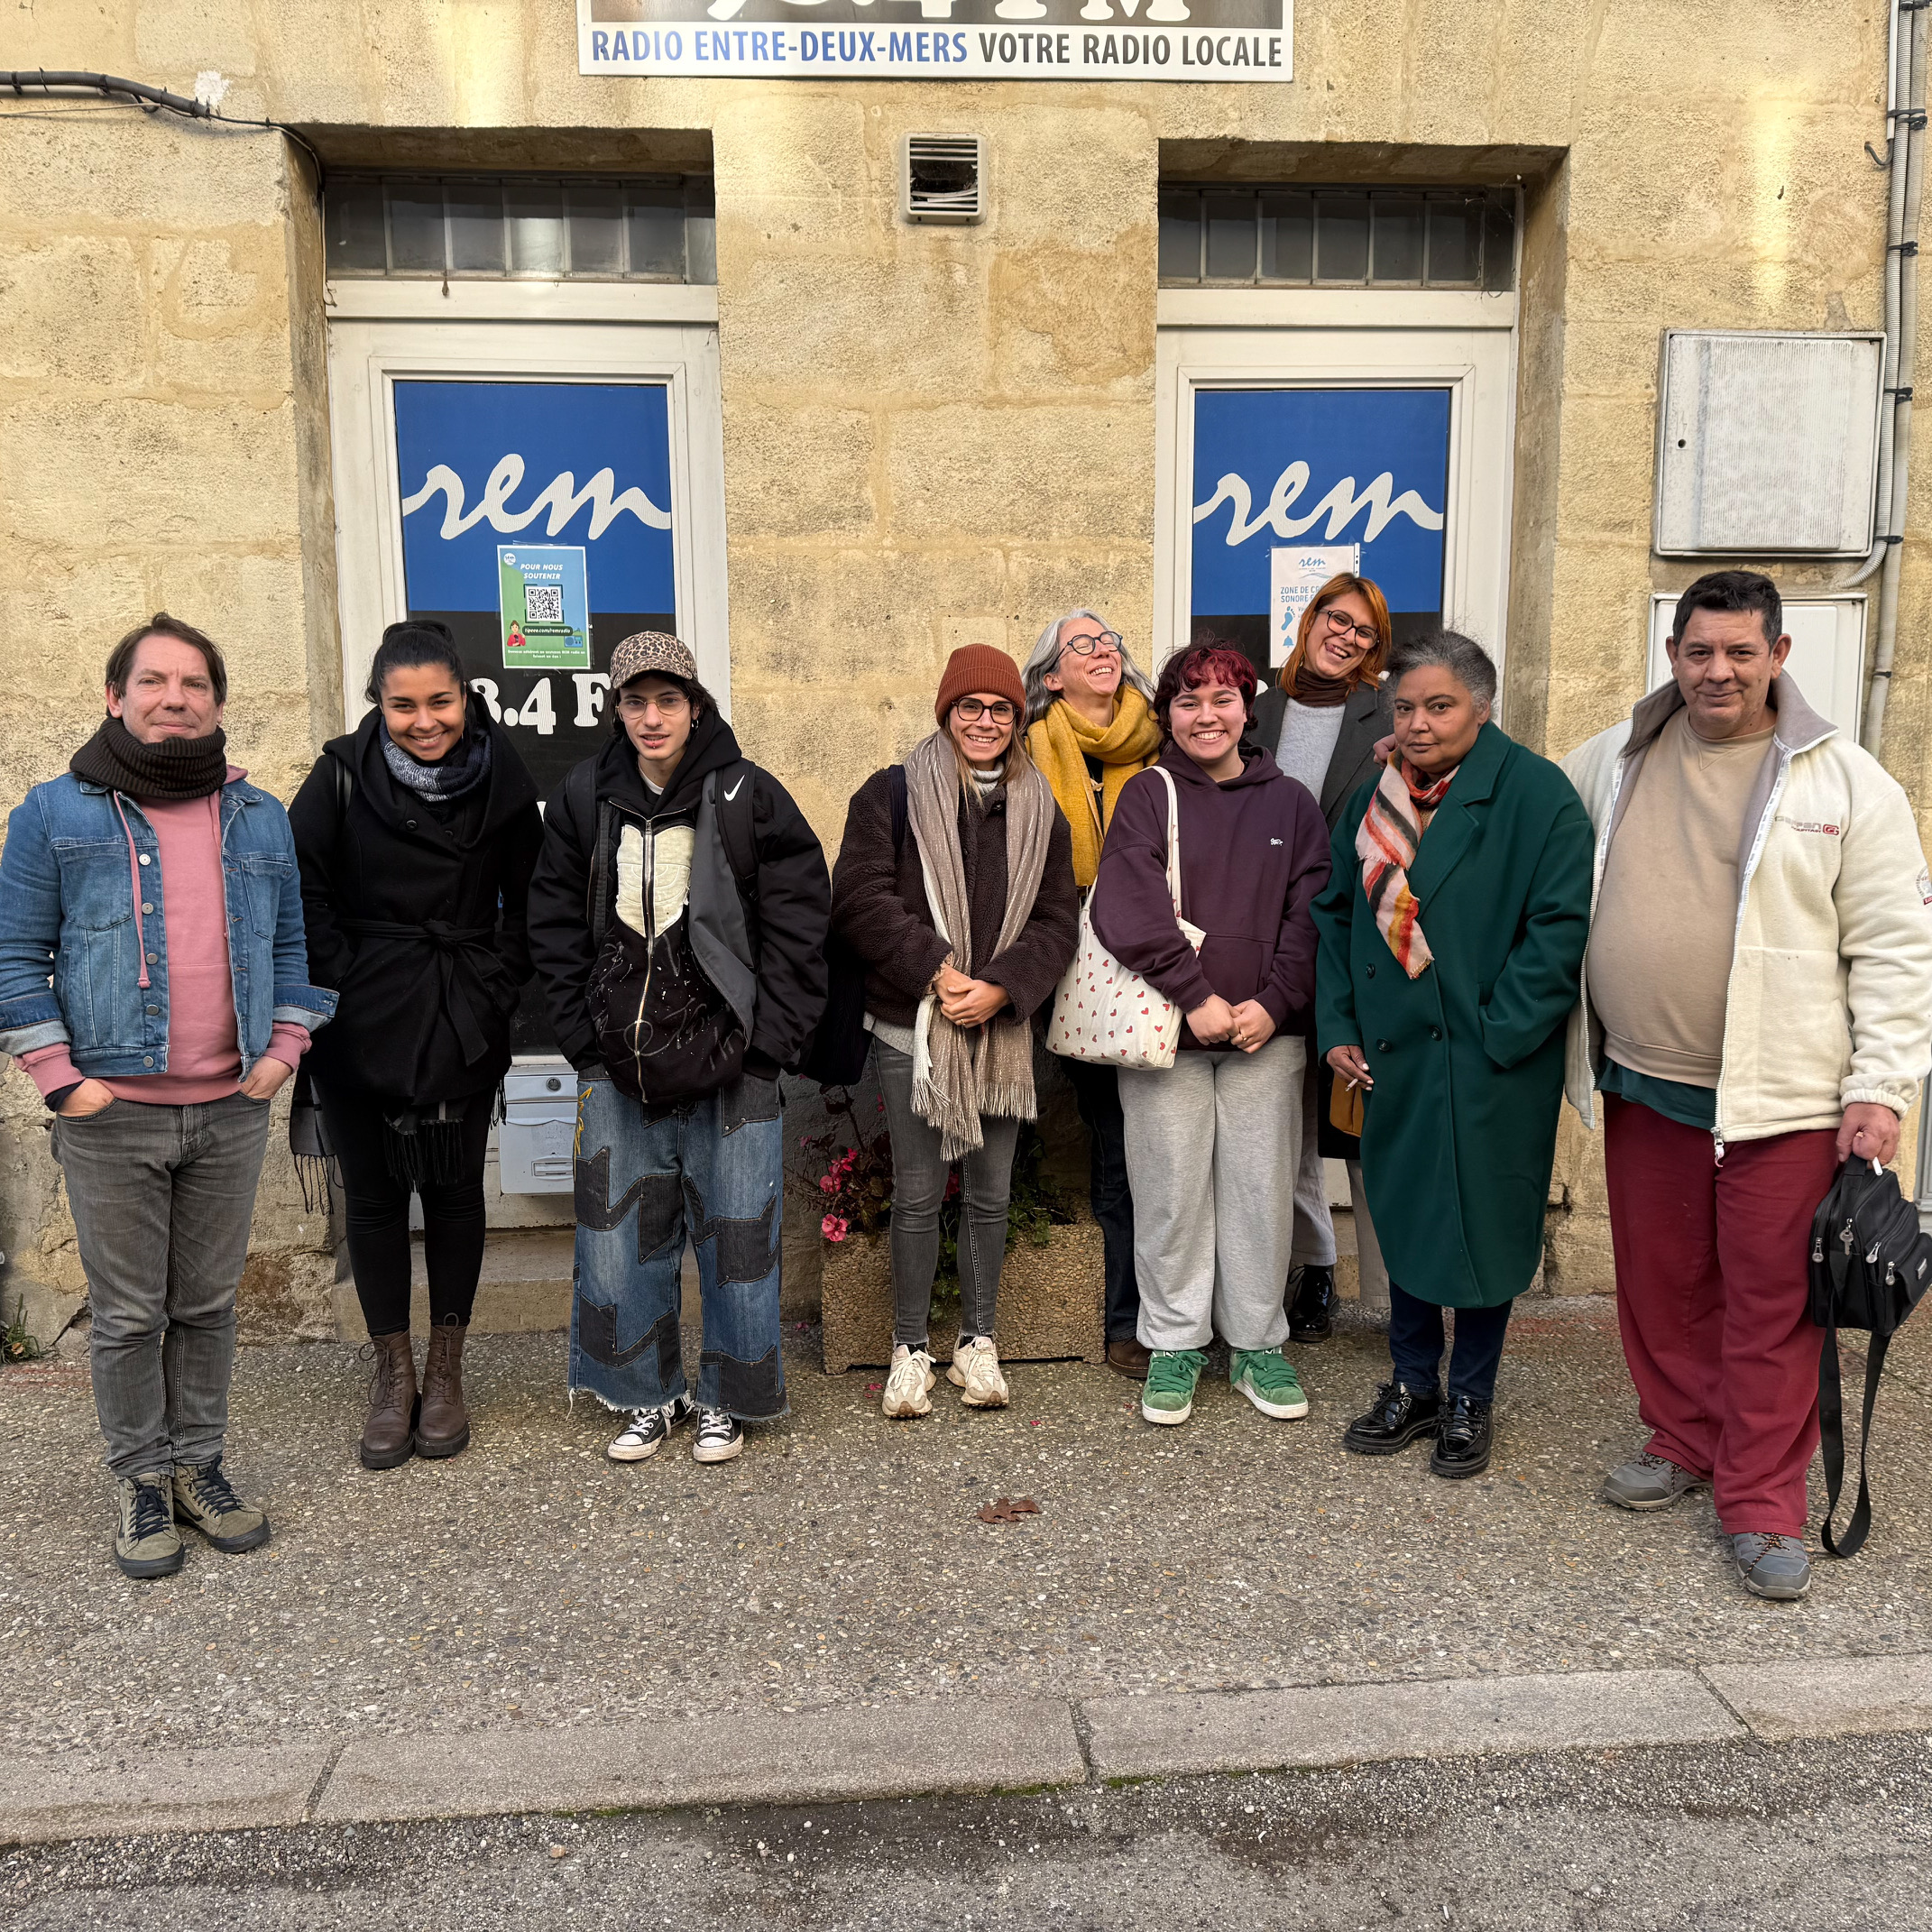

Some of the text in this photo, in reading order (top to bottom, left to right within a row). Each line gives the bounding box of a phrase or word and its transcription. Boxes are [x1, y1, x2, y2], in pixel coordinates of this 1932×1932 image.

[592, 31, 1282, 67] RADIO ENTRE-DEUX-MERS VOTRE RADIO LOCALE
[402, 453, 671, 540] rem
[1193, 460, 1443, 546] rem
[1299, 557, 1326, 567] rem
[1281, 586, 1299, 594] ZONE
[1281, 594, 1308, 603] SONORE
